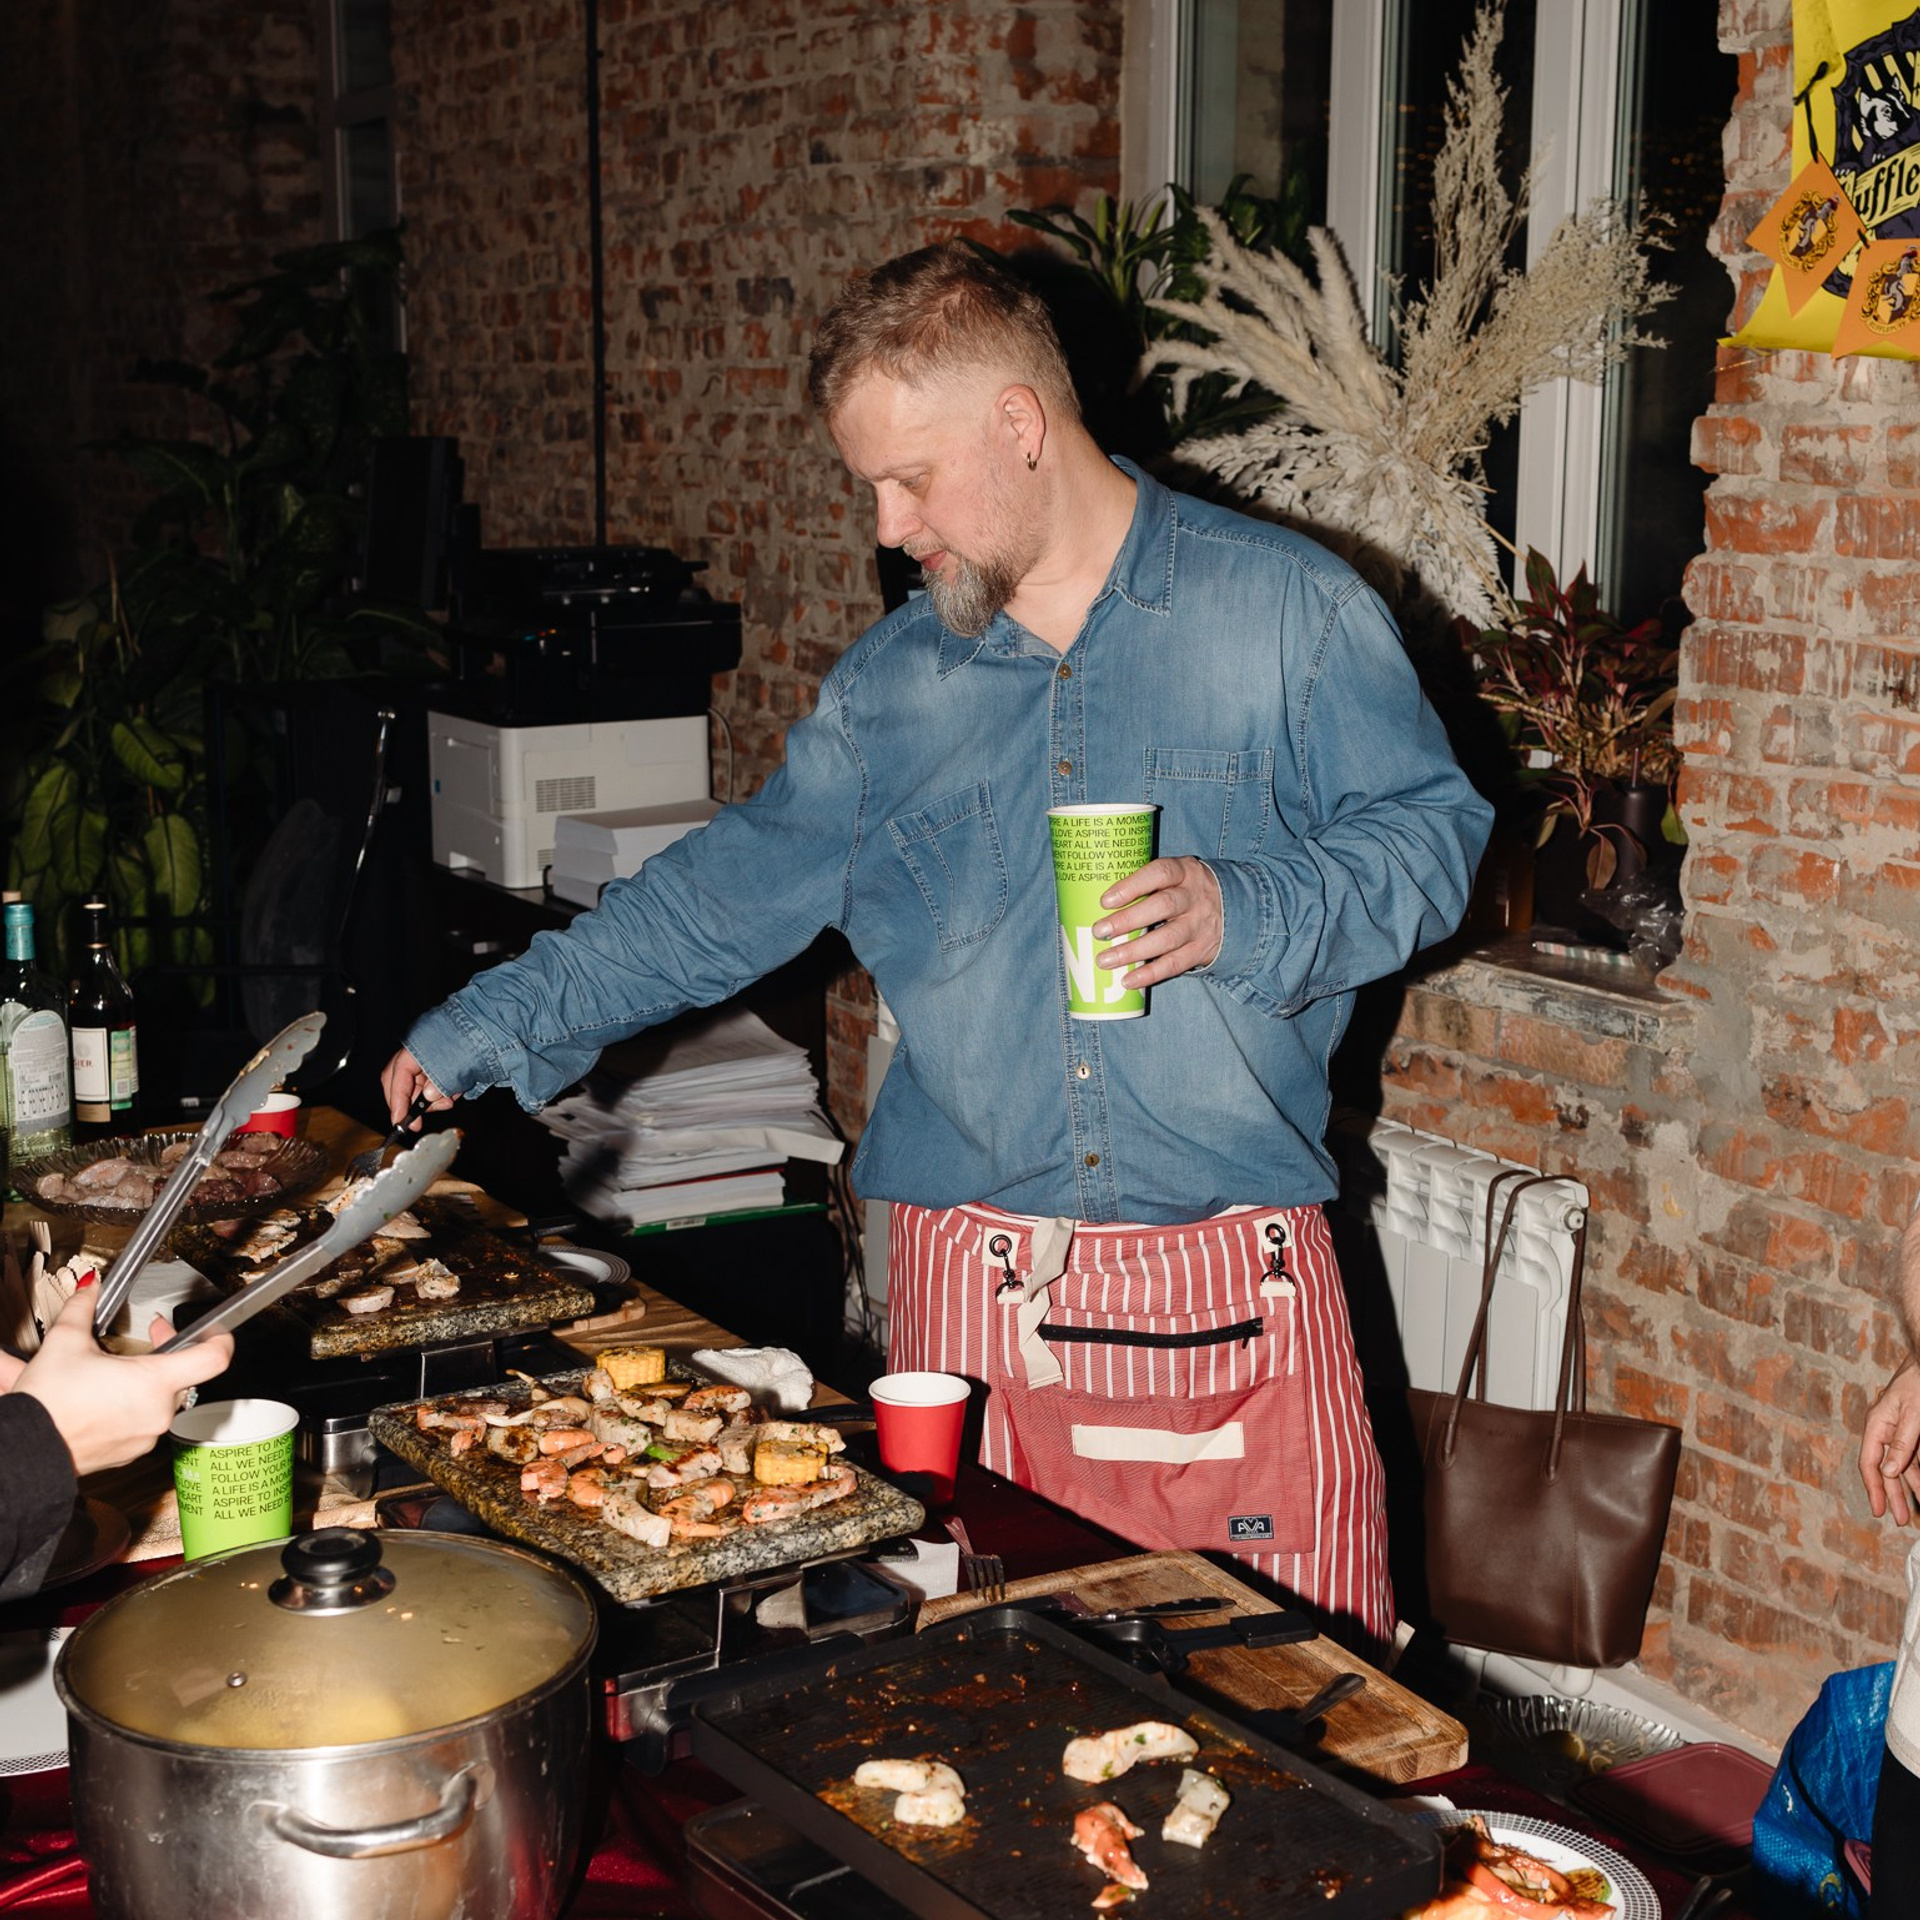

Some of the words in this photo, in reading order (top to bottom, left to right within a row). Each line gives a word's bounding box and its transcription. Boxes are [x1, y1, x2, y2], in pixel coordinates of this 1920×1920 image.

[1841, 155, 1920, 222] uffle
[1063, 818, 1070, 827] A
[1071, 818, 1090, 827] LIFE
[1094, 818, 1103, 826] IS
[1106, 817, 1114, 826] A
[1055, 829, 1073, 838] LOVE
[1075, 829, 1110, 838] ASPIRE
[1114, 828, 1126, 837] TO
[1074, 840, 1092, 849] ALL
[1094, 839, 1110, 848] WE
[1112, 838, 1136, 847] NEED
[1138, 837, 1145, 846] IS
[1054, 851, 1066, 860] ENT
[1068, 850, 1105, 860] FOLLOW
[1107, 850, 1133, 859] YOUR
[1066, 862, 1072, 870] A
[1075, 862, 1093, 870] LIFE
[1095, 862, 1104, 870] IS
[1107, 861, 1115, 870] A
[1078, 873, 1112, 882] ASPIRE
[1114, 872, 1125, 881] TO
[210, 1446, 252, 1459] ASPIRE
[256, 1442, 271, 1453] TO
[210, 1459, 233, 1472] ALL
[236, 1458, 255, 1469] WE
[259, 1451, 285, 1467] NEED
[211, 1468, 260, 1483] FOLLOW
[263, 1463, 287, 1477] YOUR
[212, 1485, 221, 1496] A
[222, 1484, 248, 1495] LIFE
[249, 1481, 259, 1493] IS
[261, 1479, 270, 1489] A
[213, 1494, 254, 1508] ASPIRE
[257, 1490, 271, 1502] TO
[214, 1508, 235, 1520] ALL
[238, 1507, 256, 1518] WE
[259, 1500, 284, 1515] NEED
